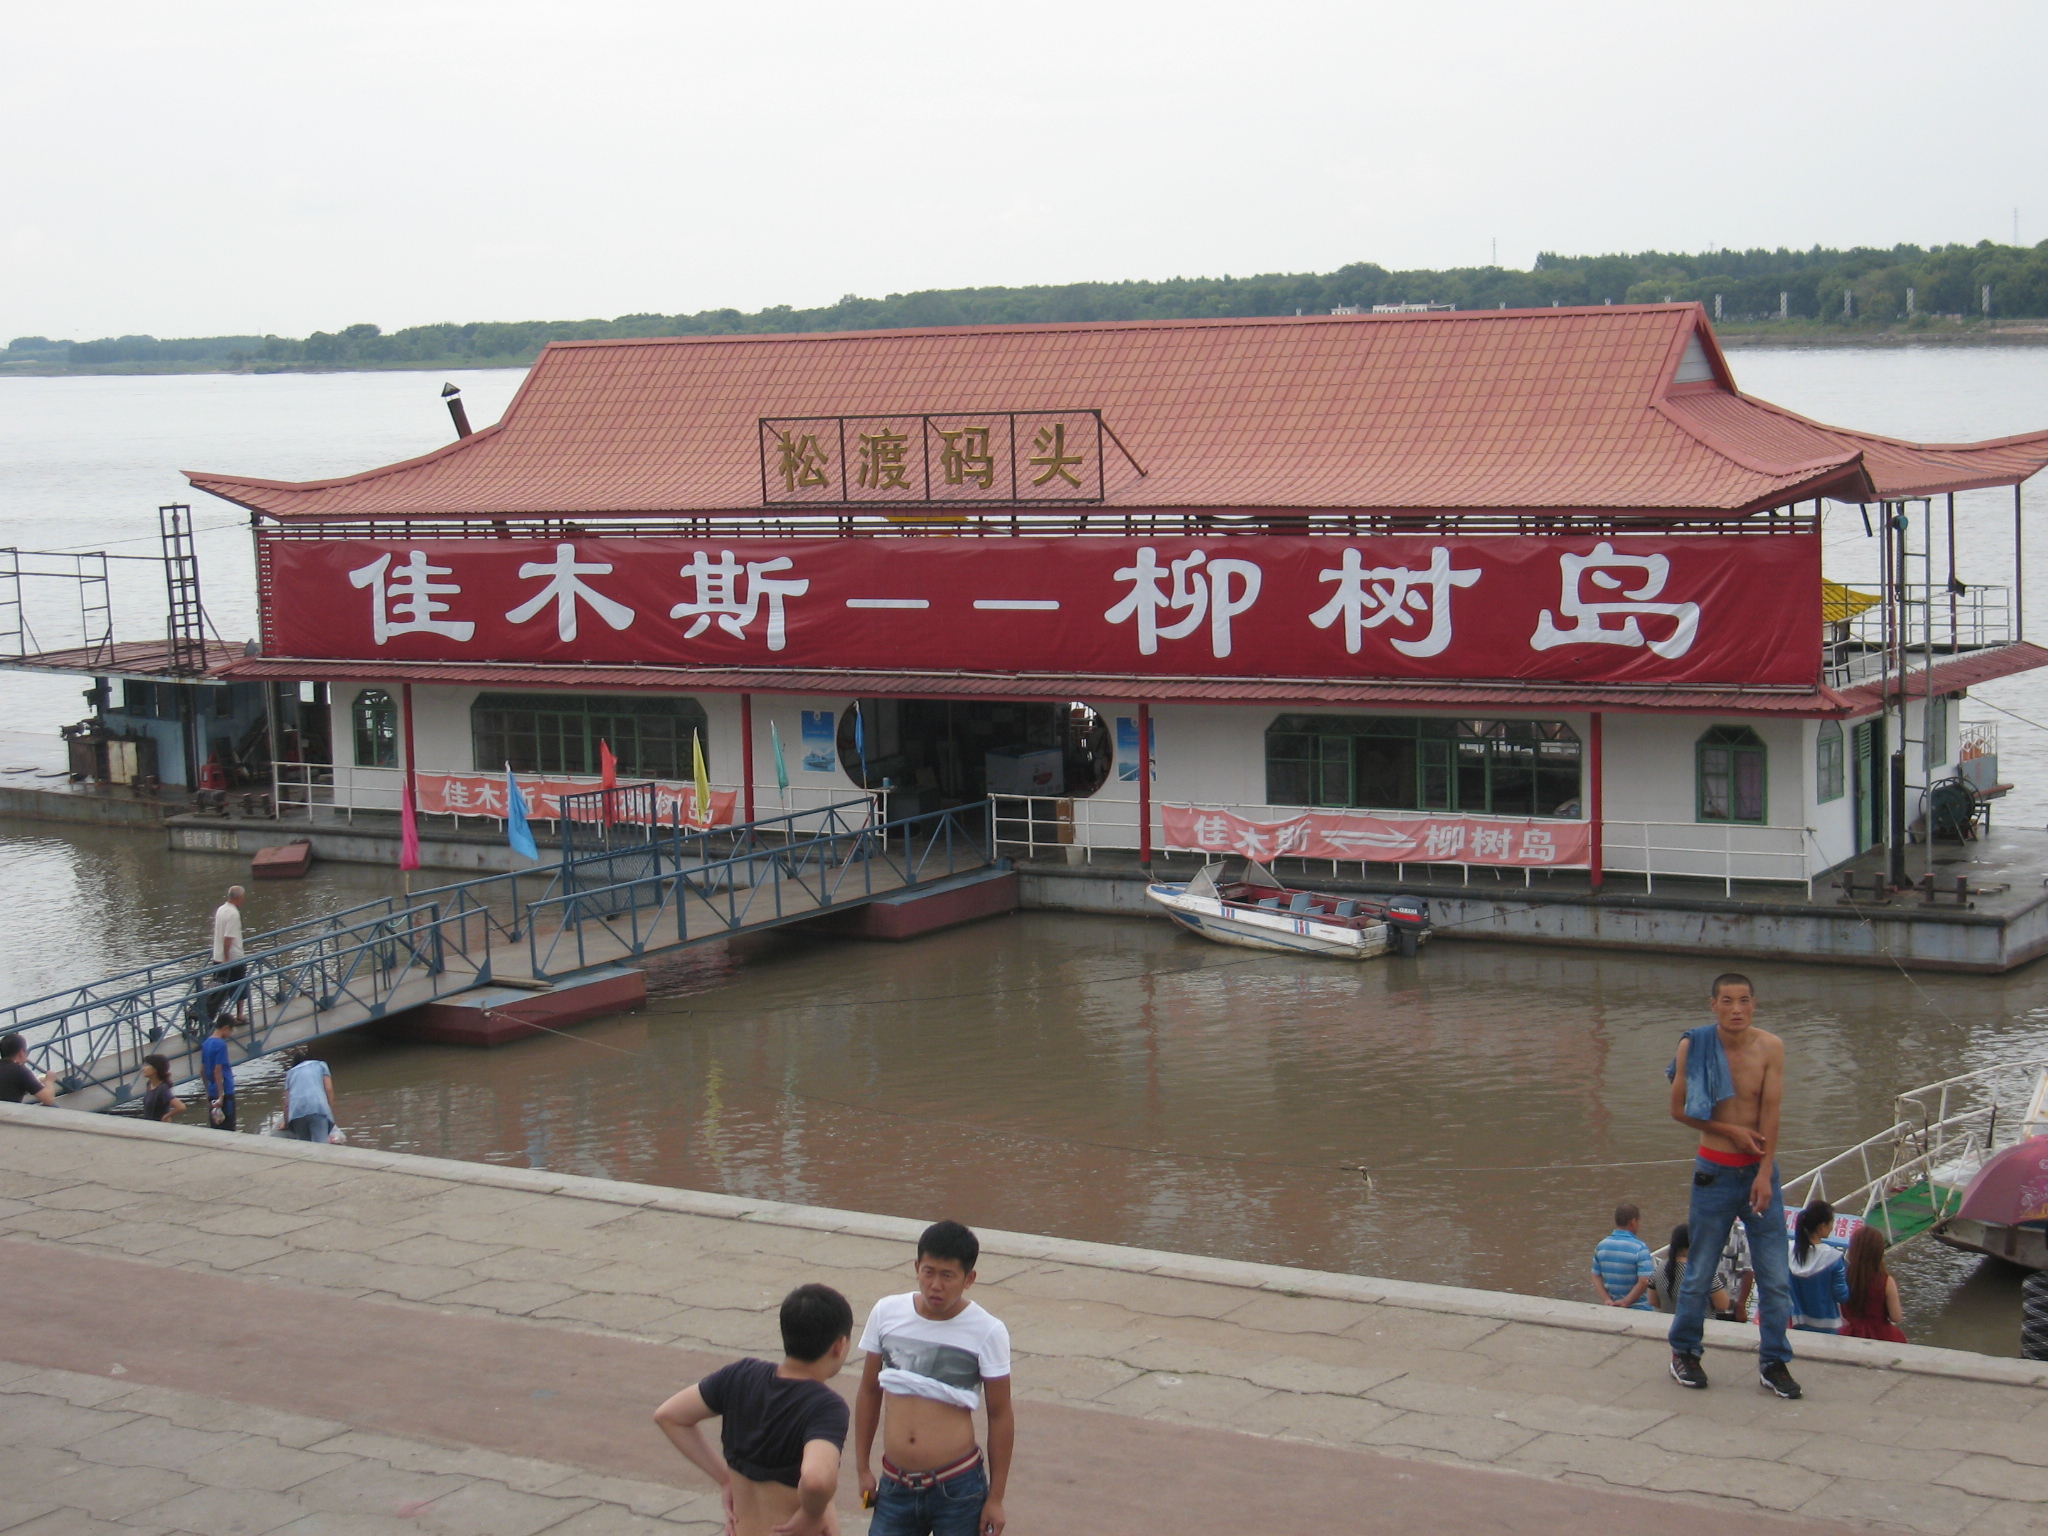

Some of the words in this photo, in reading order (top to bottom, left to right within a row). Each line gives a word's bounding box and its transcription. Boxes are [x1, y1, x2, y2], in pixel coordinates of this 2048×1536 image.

[777, 423, 1083, 492] 松渡码头
[1193, 814, 1313, 858] 佳木斯
[1424, 823, 1557, 862] 柳树岛
